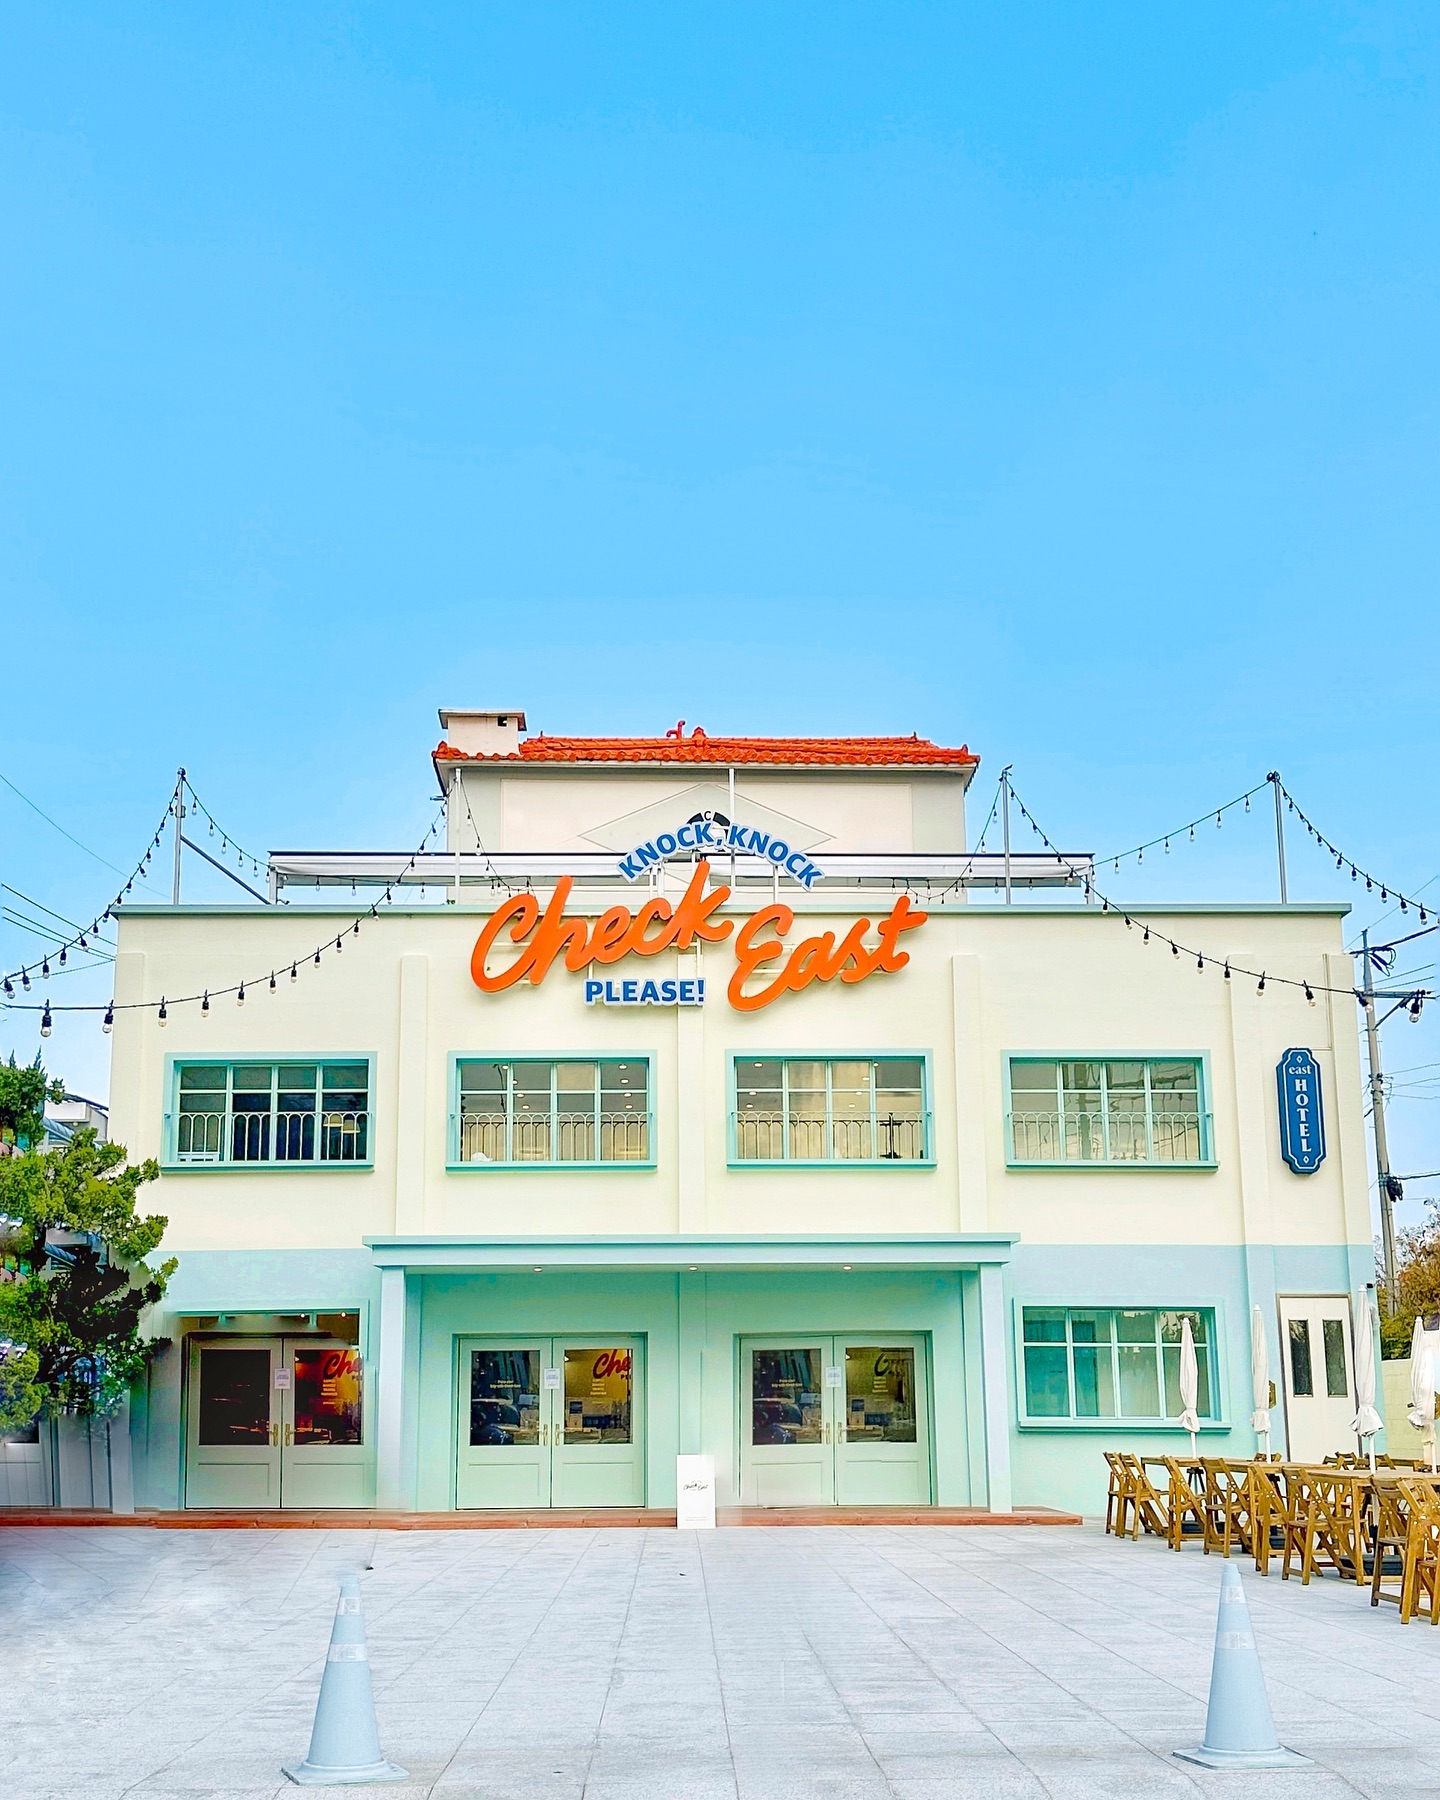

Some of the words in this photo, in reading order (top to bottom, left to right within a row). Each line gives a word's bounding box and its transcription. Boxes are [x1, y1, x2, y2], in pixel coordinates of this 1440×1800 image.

[619, 822, 724, 880] KNOCK,
[728, 825, 822, 888] KNOCK
[471, 860, 734, 993] Check
[728, 895, 928, 1013] East
[585, 979, 705, 1003] PLEASE!
[1288, 1065, 1312, 1075] east
[1294, 1079, 1312, 1152] HOTEL
